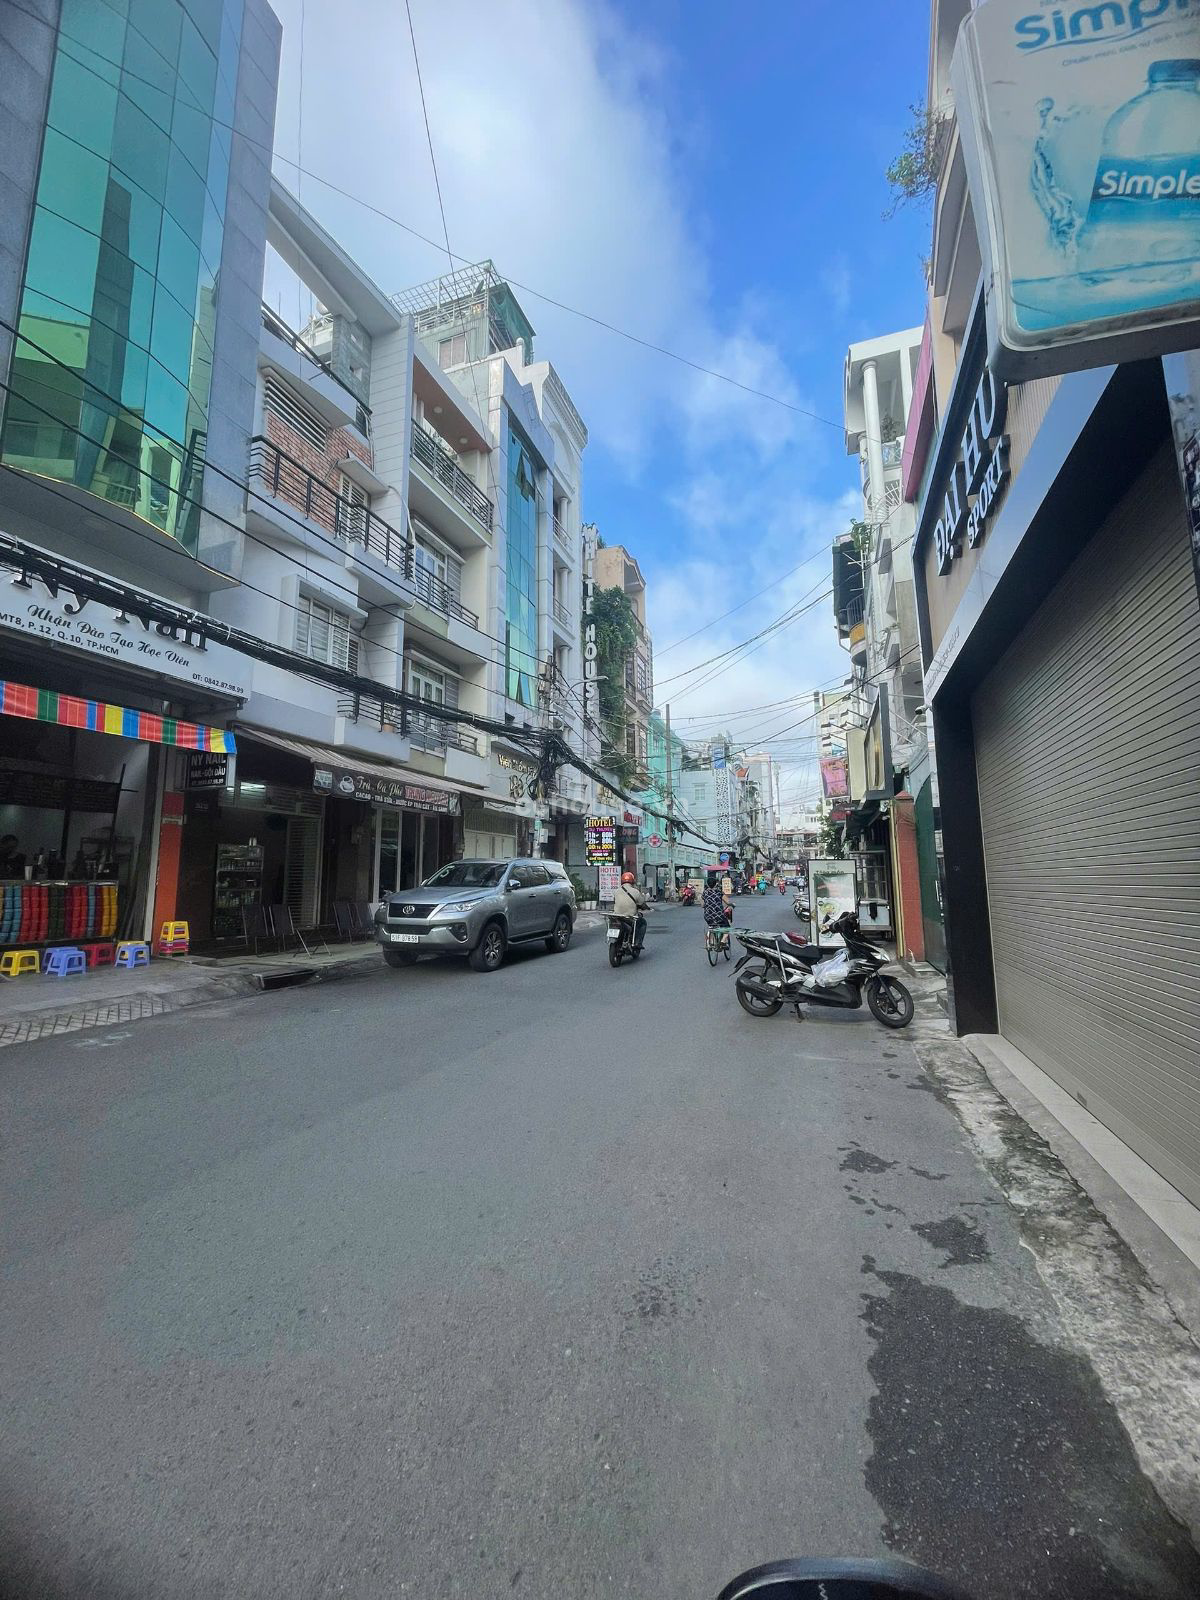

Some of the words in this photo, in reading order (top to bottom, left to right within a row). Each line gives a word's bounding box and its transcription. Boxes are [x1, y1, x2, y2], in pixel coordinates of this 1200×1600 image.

[1015, 0, 1190, 49] Simp
[1098, 168, 1200, 201] Simple
[966, 434, 1003, 549] SPORT
[87, 639, 119, 656] TP.HCM
[110, 631, 134, 649] Tạo
[584, 623, 598, 718] HOUSE
[206, 752, 226, 764] NAIL
[588, 818, 613, 827] HOTEL
